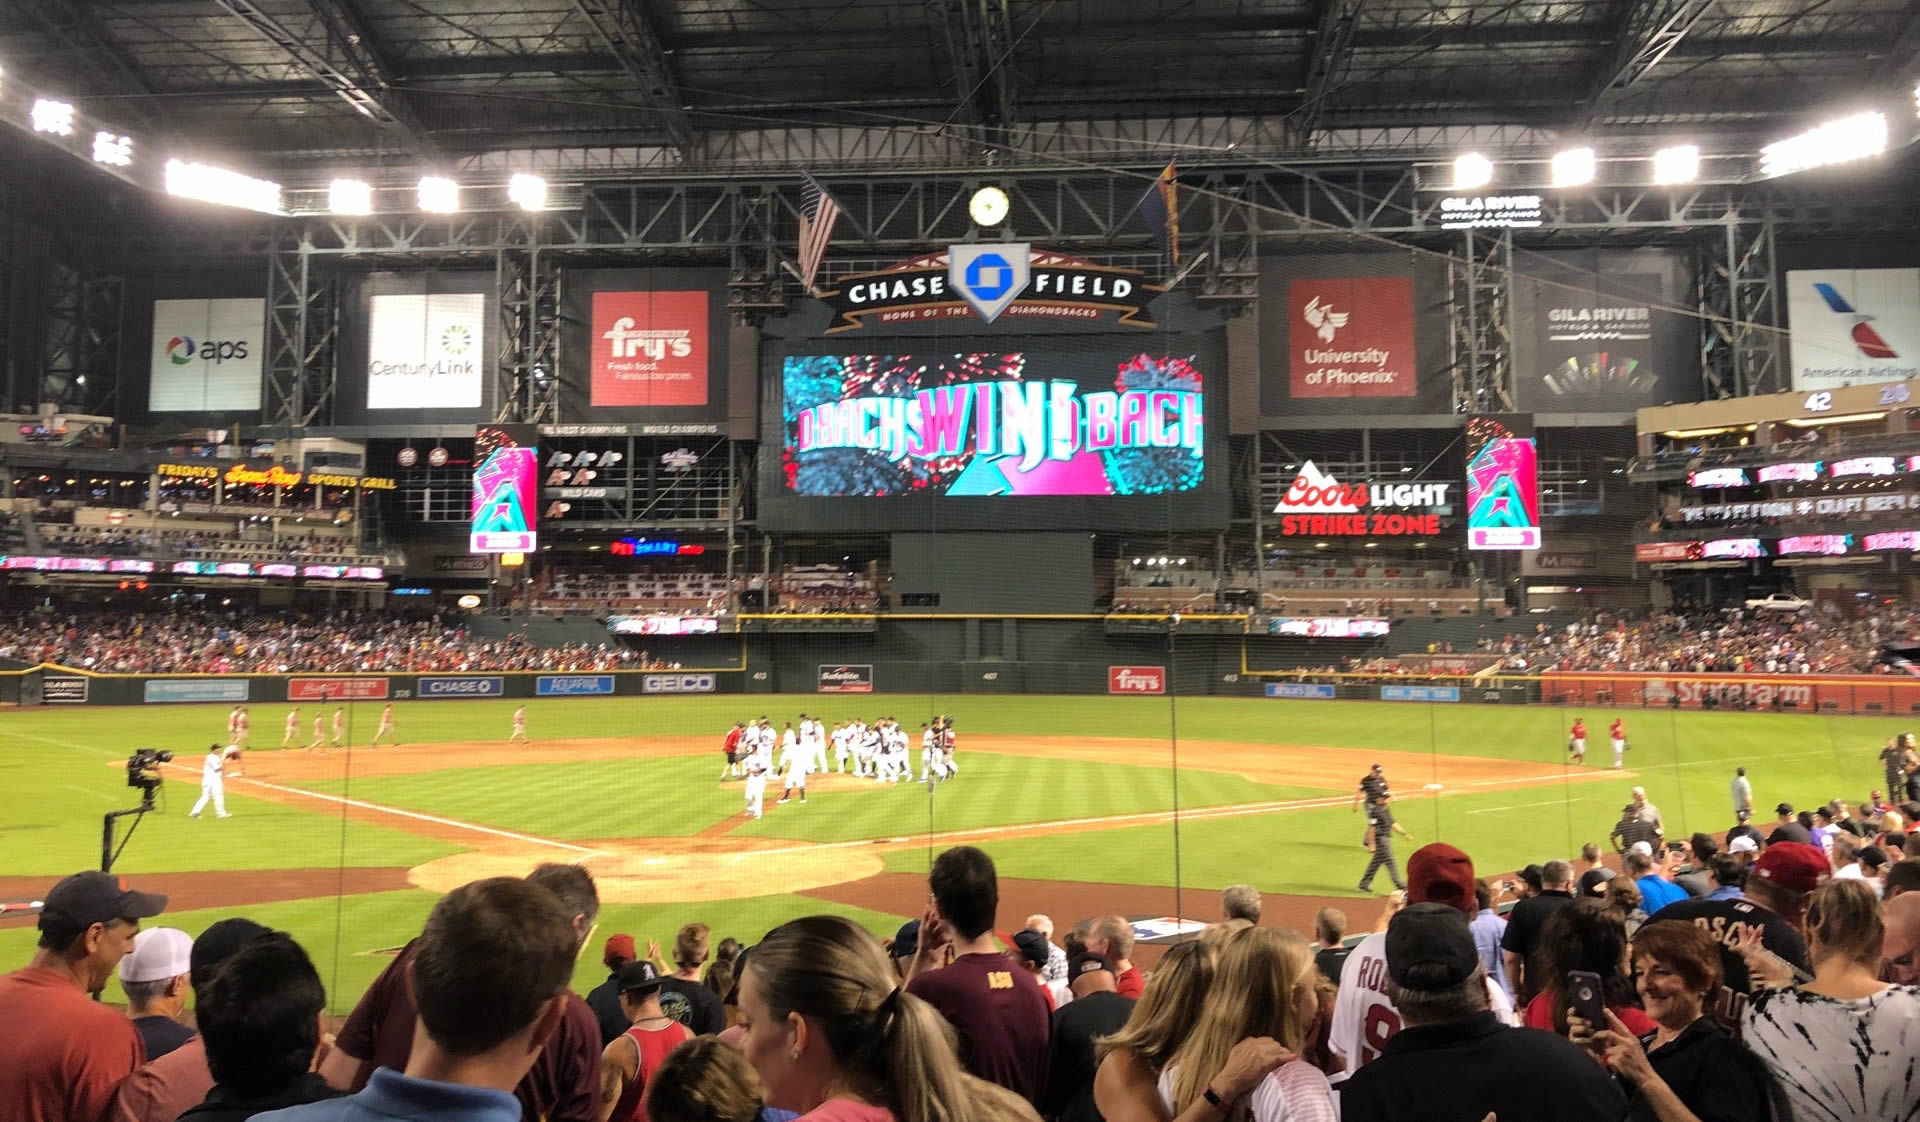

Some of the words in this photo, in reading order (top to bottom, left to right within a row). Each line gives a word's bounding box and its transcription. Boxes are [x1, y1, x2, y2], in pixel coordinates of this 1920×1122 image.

[1440, 197, 1484, 211] GILA
[1485, 196, 1541, 210] RIVER
[849, 276, 944, 303] CHASE
[1036, 274, 1131, 297] FIELD
[882, 310, 915, 321] HOME
[923, 309, 937, 317] OF
[946, 307, 969, 316] THE
[1009, 306, 1097, 317] DIAMONDBACKS
[1548, 308, 1591, 321] GILA
[1592, 307, 1649, 321] RIVER
[602, 317, 692, 361] fry's
[200, 341, 248, 364] aps
[1304, 348, 1390, 367] University
[370, 360, 474, 378] CenturyLink
[1305, 368, 1324, 384] of
[1326, 368, 1394, 384] Phoenix
[1804, 391, 1832, 411] 42
[157, 463, 218, 478] FRIDAY'S
[307, 474, 358, 487] SPORTS
[360, 476, 397, 489] GRILL
[1282, 475, 1369, 507] Coors
[1370, 484, 1449, 507] LIGHT
[1281, 514, 1368, 535] STRIKE
[1371, 514, 1440, 535] ZONE
[430, 681, 479, 693] CHASE
[646, 677, 714, 692] GEICO
[1115, 669, 1160, 691] fry's
